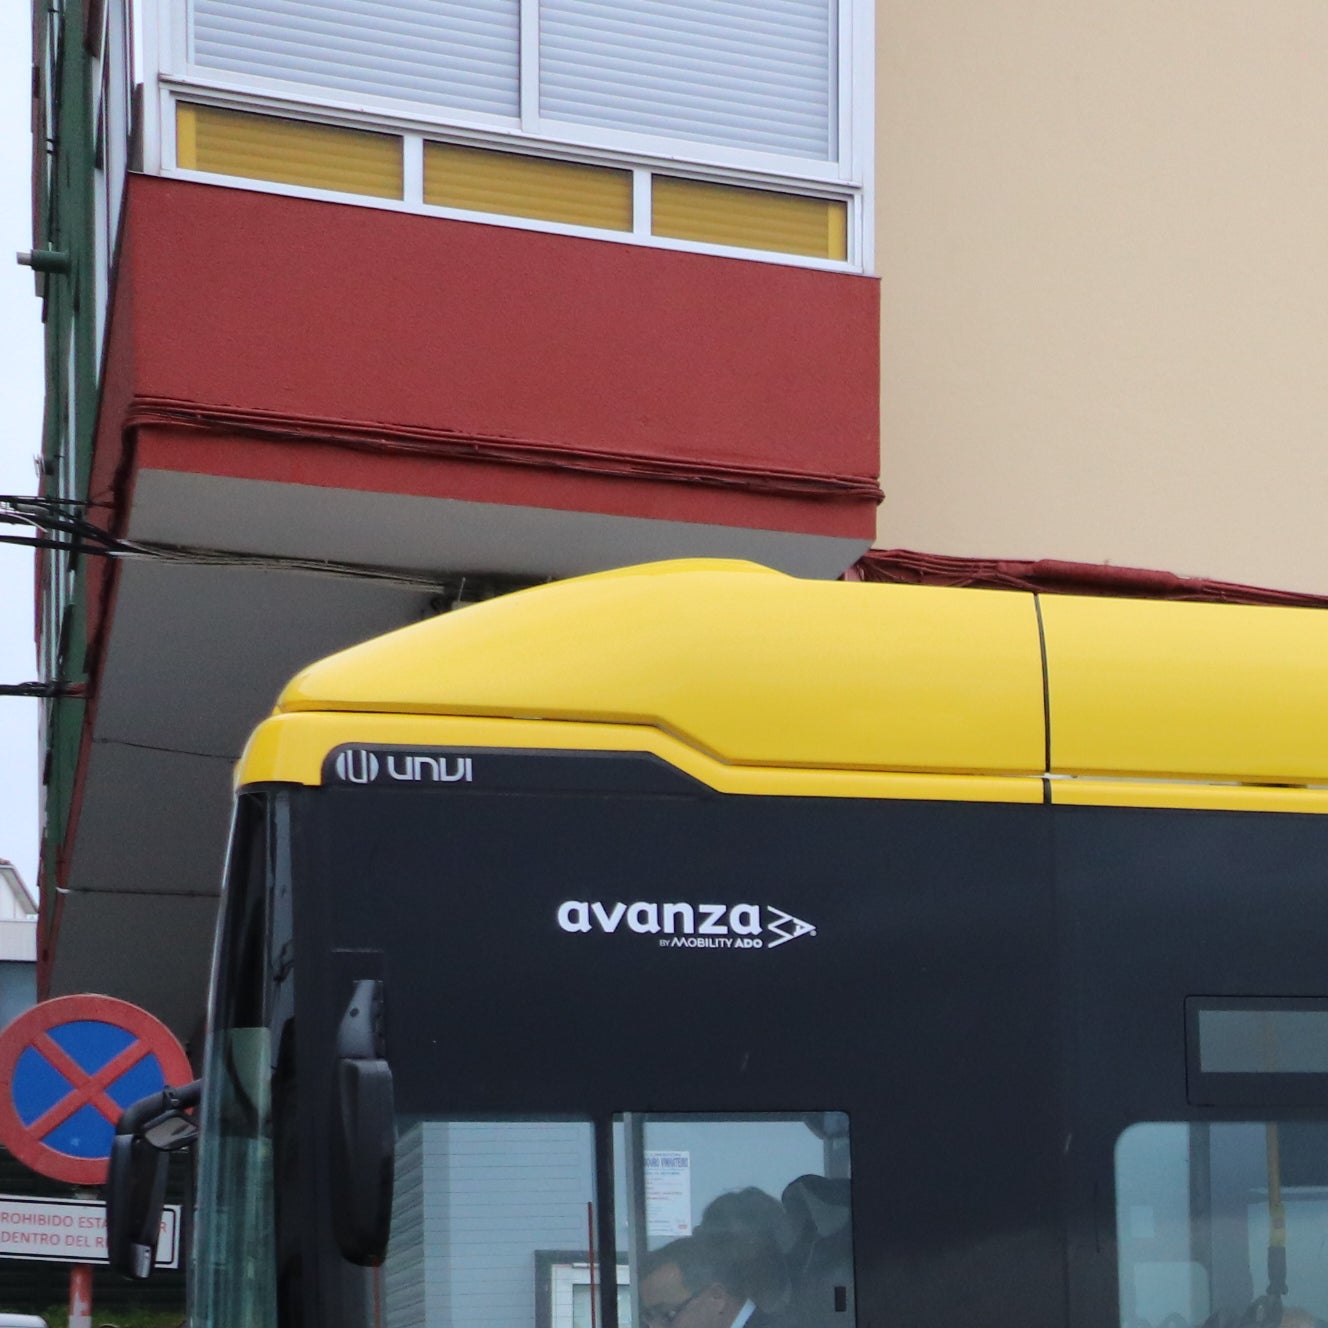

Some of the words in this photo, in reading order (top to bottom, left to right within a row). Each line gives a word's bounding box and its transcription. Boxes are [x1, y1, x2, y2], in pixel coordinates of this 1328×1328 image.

[557, 900, 763, 936] avanza
[671, 937, 733, 949] MOBILITY
[734, 937, 763, 949] ADO
[0, 1211, 74, 1229] ROHIBIDO
[1, 1230, 61, 1247] DENTRO
[65, 1234, 91, 1248] DEL
